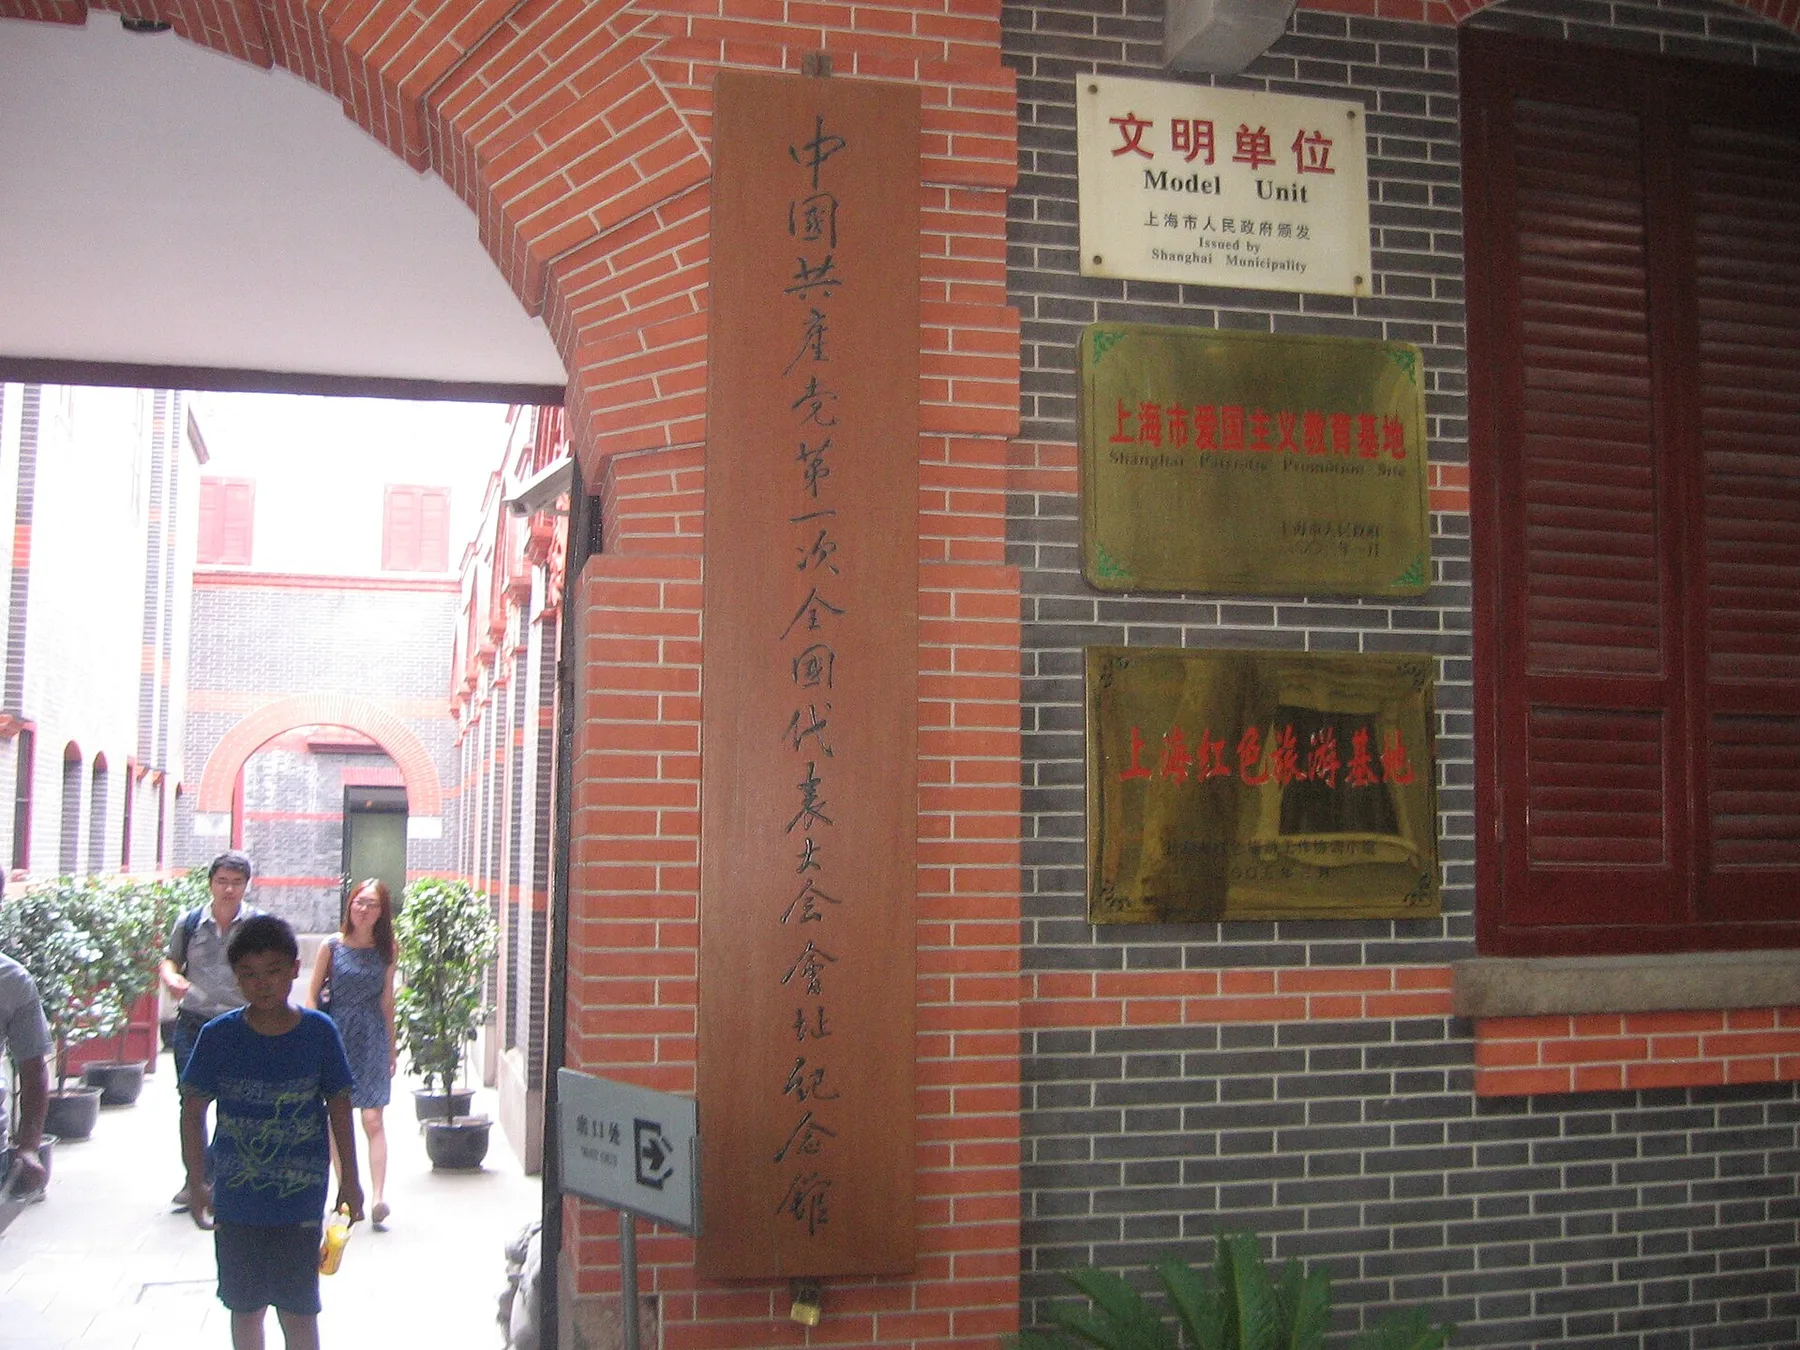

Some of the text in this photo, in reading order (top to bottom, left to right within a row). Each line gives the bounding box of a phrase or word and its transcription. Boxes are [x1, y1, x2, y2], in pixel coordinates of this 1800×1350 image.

[1109, 112, 1335, 175] 文明单位
[1143, 169, 1309, 204] Model Unit
[1143, 210, 1311, 241] 上海市人民政府颁发
[1151, 248, 1308, 275] Shanghai Municipality
[1199, 236, 1261, 254] Issued by
[1109, 397, 1407, 461] 上海市爱国主义教育基地
[1109, 448, 1184, 469] Shanghai
[1119, 724, 1415, 788] 上海红色旅游基地
